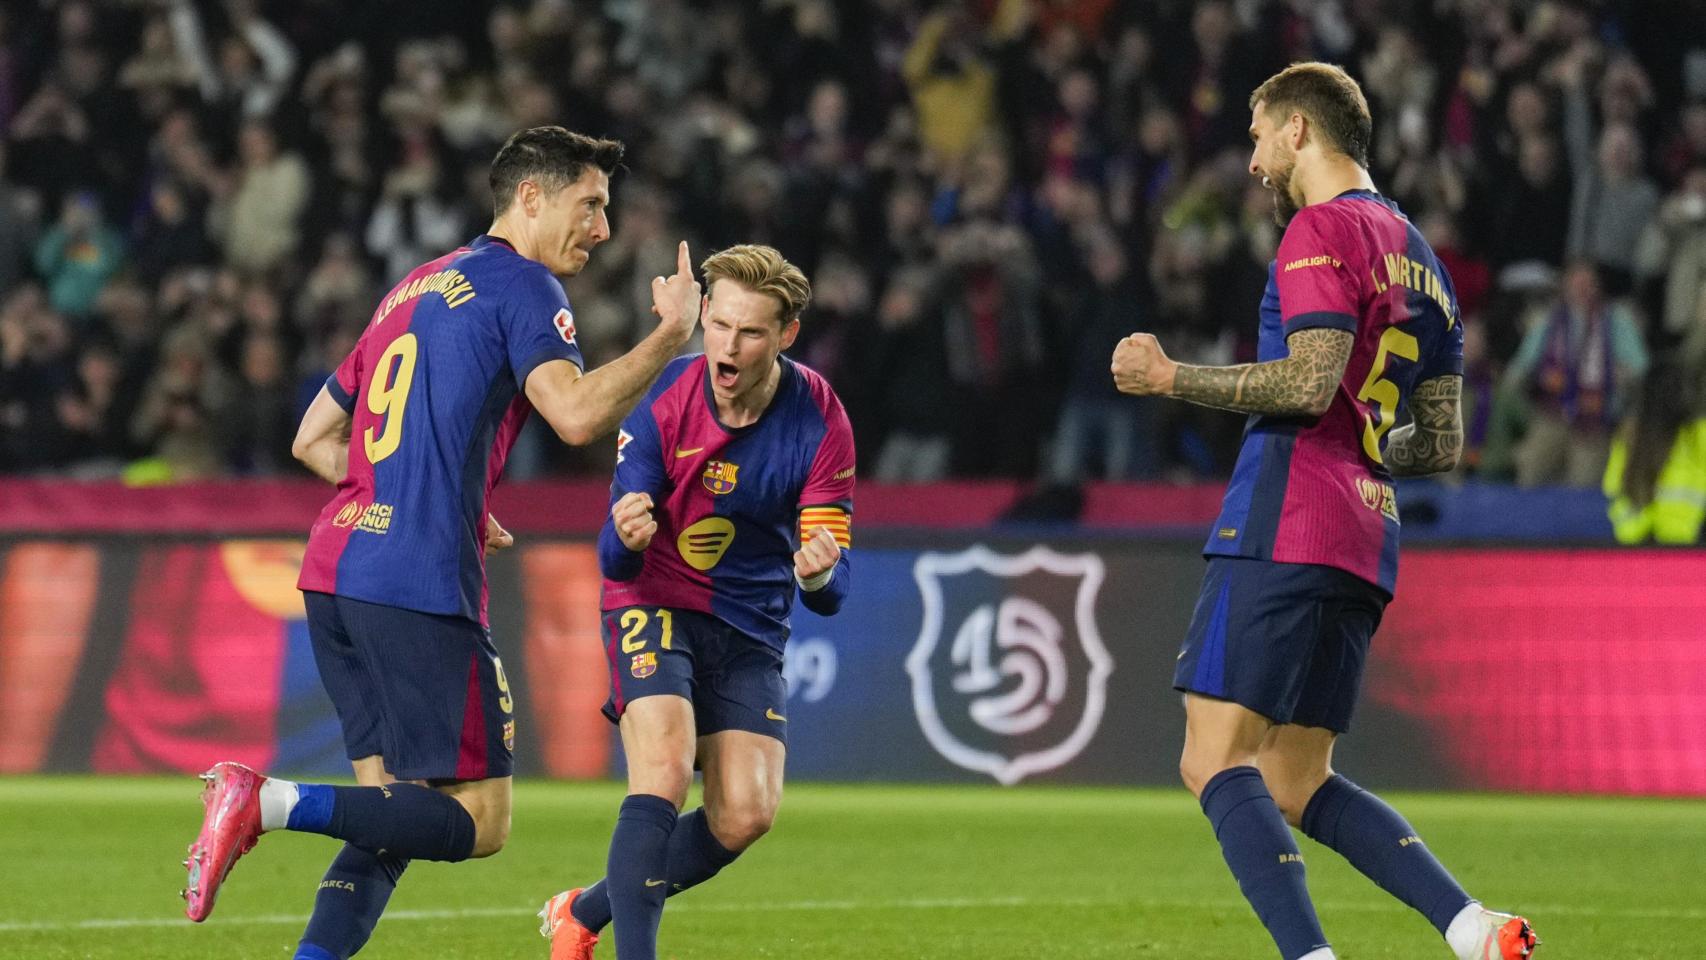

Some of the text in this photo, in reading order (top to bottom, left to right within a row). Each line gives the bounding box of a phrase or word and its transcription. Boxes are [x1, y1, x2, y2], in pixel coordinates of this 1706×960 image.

[1284, 255, 1332, 272] AMBILIGHT
[364, 332, 418, 465] 9
[1357, 326, 1419, 464] 5
[620, 608, 672, 654] 21
[494, 656, 514, 714] 9
